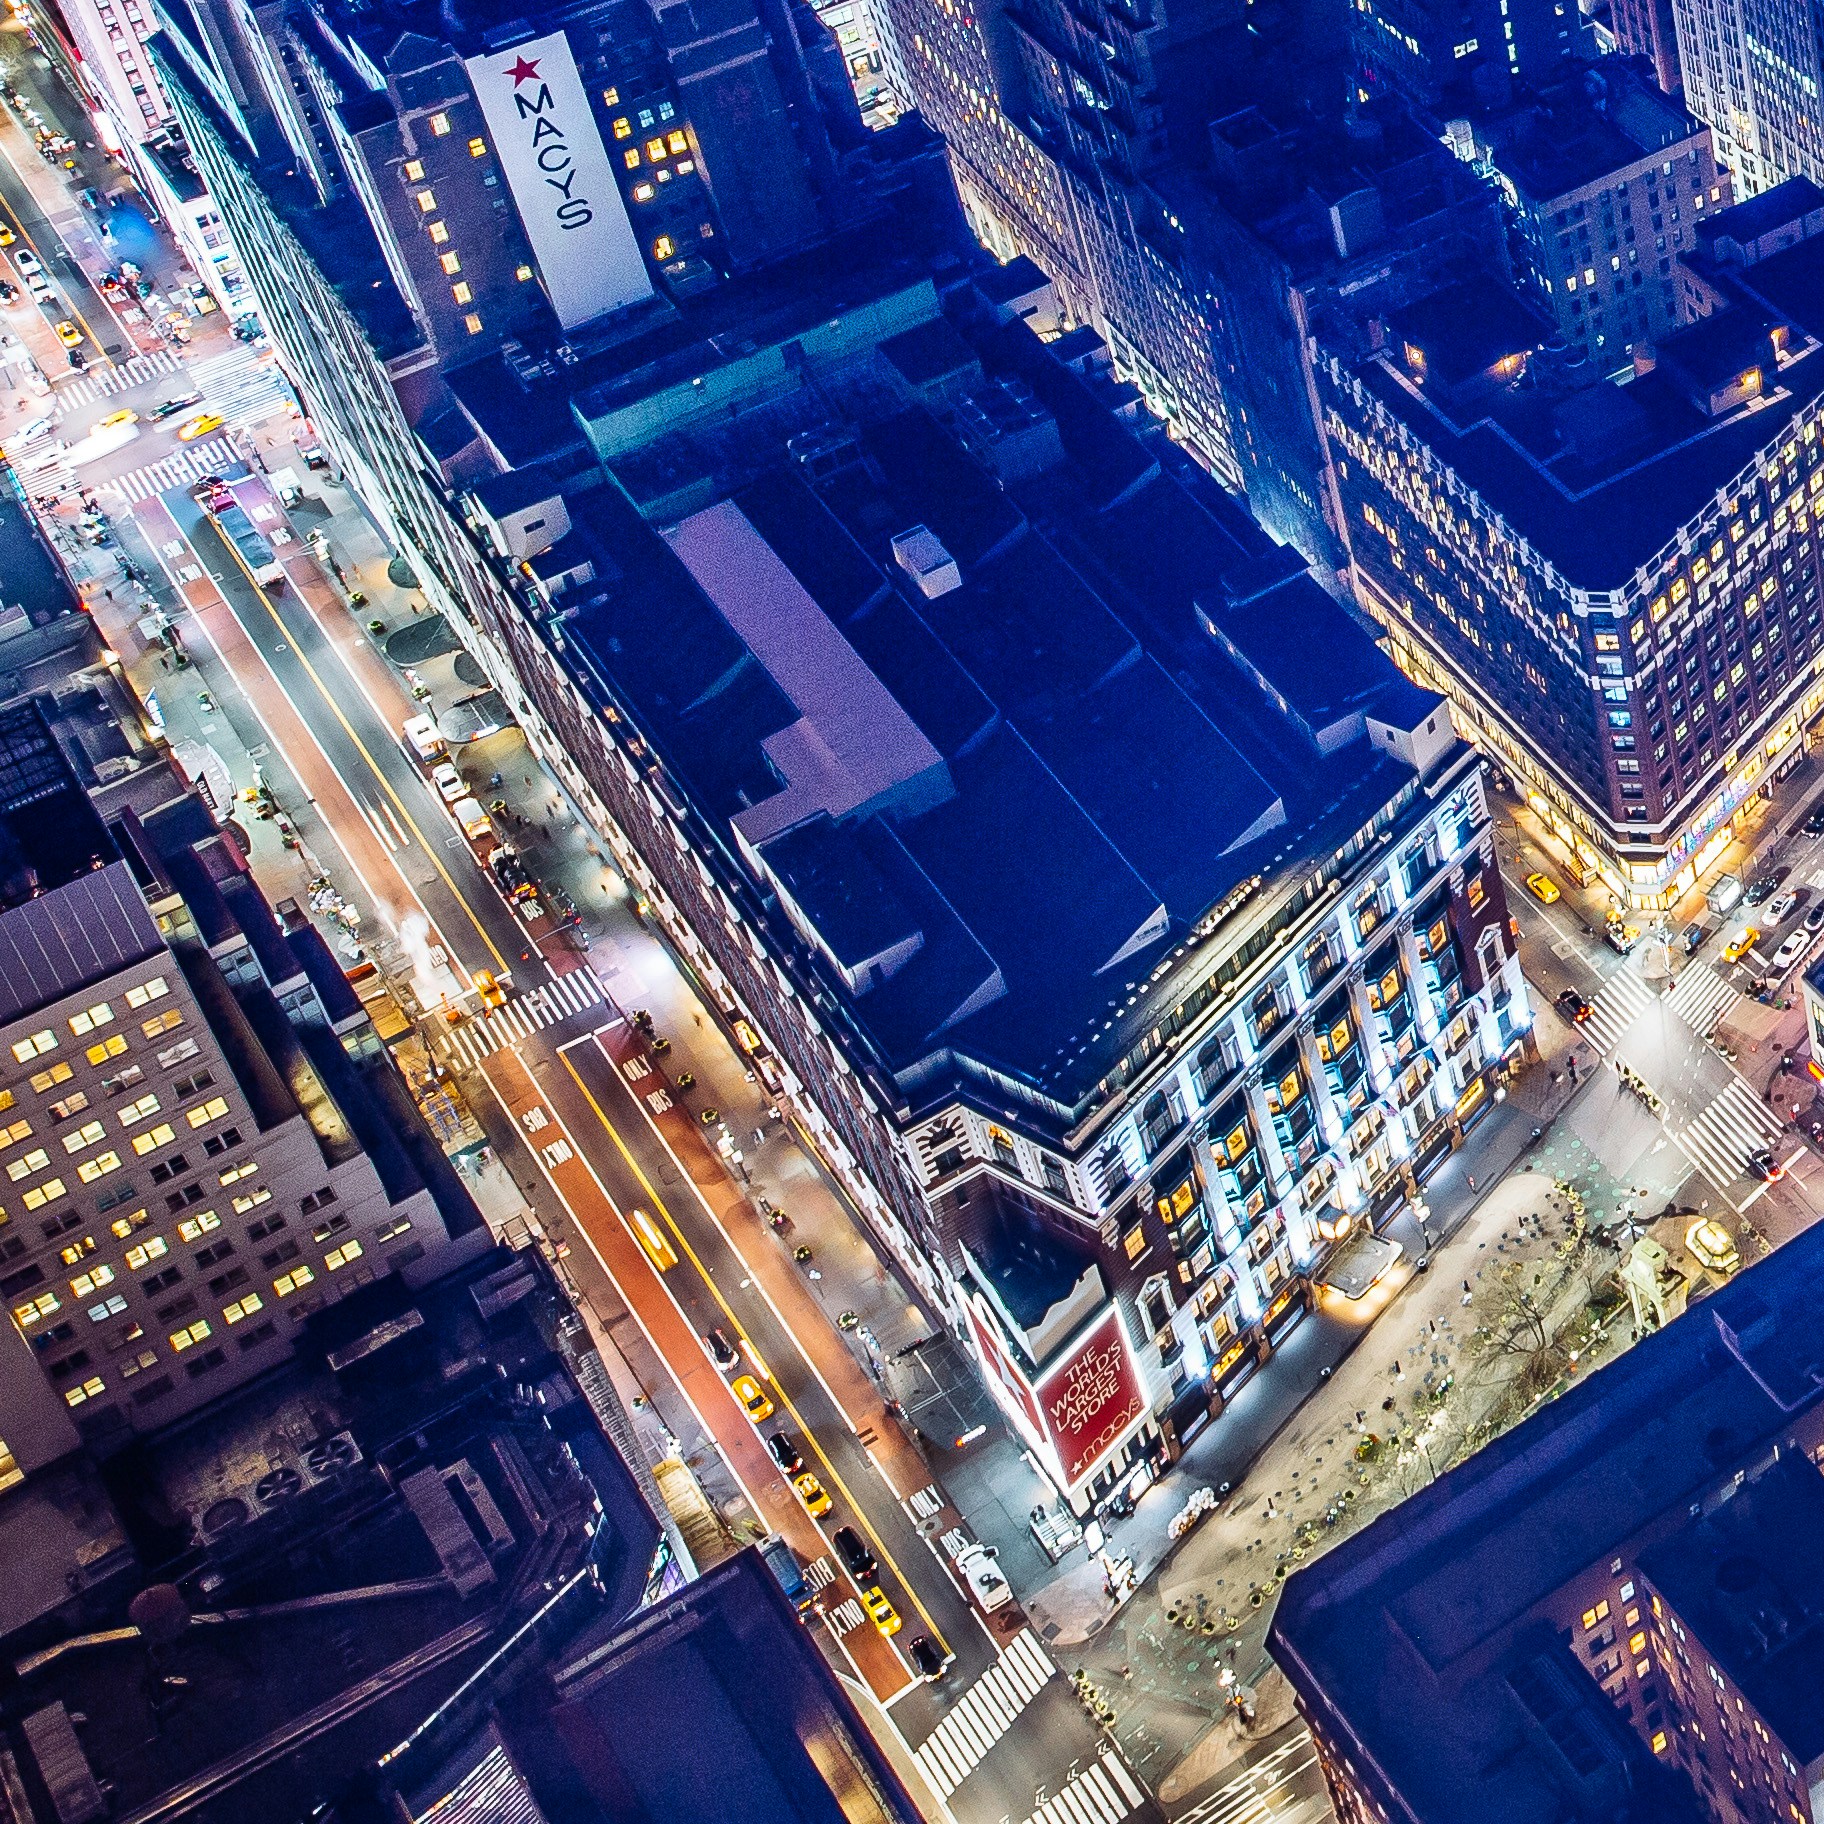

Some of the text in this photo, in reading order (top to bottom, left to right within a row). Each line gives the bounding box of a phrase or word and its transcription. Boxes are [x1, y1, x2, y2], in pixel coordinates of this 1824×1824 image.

[513, 82, 593, 230] MACYS
[519, 899, 545, 922] BUS
[622, 1053, 654, 1082] ONLY
[646, 1087, 673, 1115] BUS
[522, 1105, 549, 1133] BUS
[541, 1137, 575, 1170] ONLY
[1050, 1340, 1123, 1418] WORLD'S
[1064, 1346, 1098, 1383] THE
[1054, 1358, 1122, 1433] LARGEST
[1071, 1378, 1120, 1435] STORE
[909, 1483, 945, 1518] ONLY
[939, 1527, 969, 1558] BUS
[828, 1598, 866, 1638] ONLY
